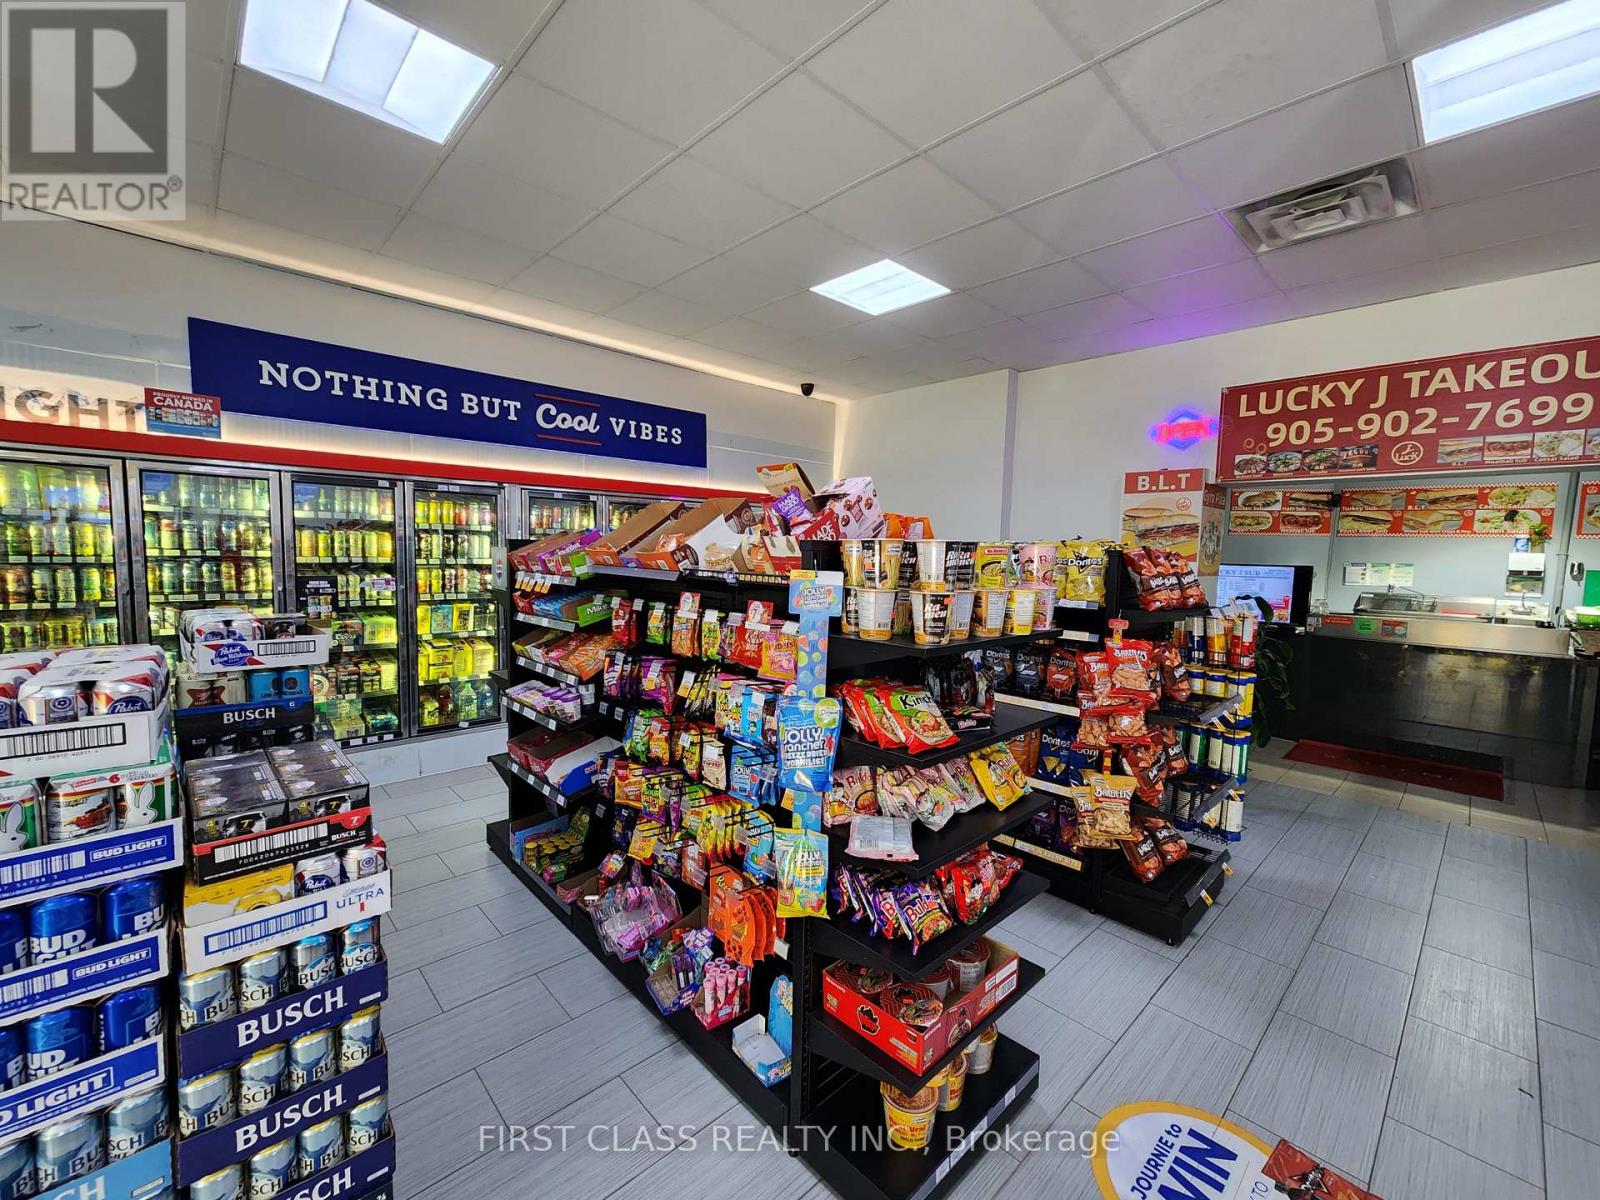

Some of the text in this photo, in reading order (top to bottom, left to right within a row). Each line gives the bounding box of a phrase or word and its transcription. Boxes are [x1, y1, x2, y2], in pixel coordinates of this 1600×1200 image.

[153, 396, 214, 412] CANADA
[258, 359, 684, 446] NOTHING BUT Cool VIBES
[1238, 377, 1365, 418] LUCKY
[1370, 375, 1389, 409] J
[1265, 391, 1595, 449] 905-902-7699
[1068, 558, 1103, 566] Doritos
[1050, 656, 1077, 668] Doritos
[114, 701, 142, 713] Pabst
[223, 707, 276, 725] BUSCH
[784, 726, 822, 744] JOLLY
[1042, 734, 1071, 748] Doritos
[331, 830, 357, 842] BUSCH
[92, 837, 165, 861] BUD LIGHT
[336, 887, 384, 909] ULTRA
[75, 963, 107, 978] BUD
[108, 949, 149, 968] LIGHT
[236, 985, 345, 1048] BUSCH
[17, 1073, 109, 1119] LIGHT
[235, 1084, 345, 1153] BUSCH
[1130, 1123, 1183, 1200] JOURNIE to
